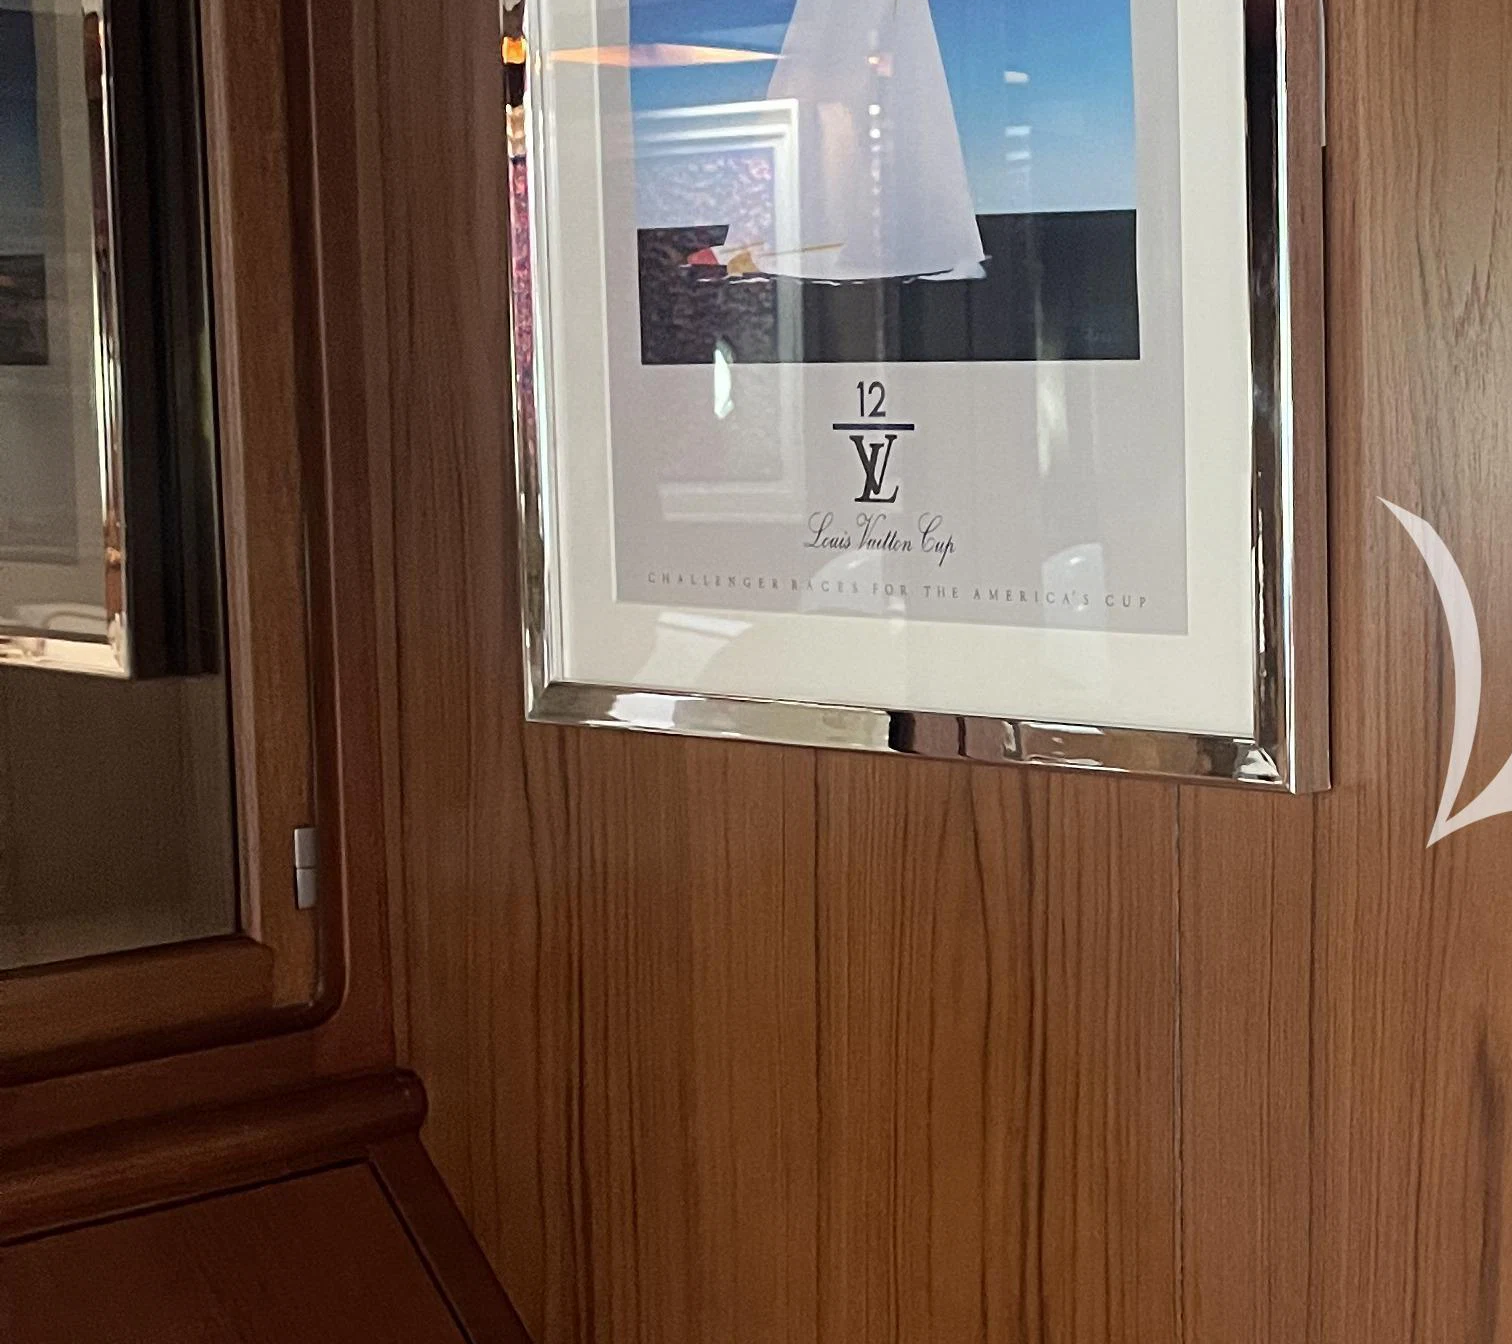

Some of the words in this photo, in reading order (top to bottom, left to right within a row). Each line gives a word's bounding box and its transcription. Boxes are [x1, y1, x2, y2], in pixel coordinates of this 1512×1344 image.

[856, 381, 886, 417] 12
[803, 511, 851, 550] Louis
[856, 512, 913, 552] Vuitton
[918, 512, 955, 567] Cup
[648, 573, 779, 590] CHALLENGER
[791, 576, 859, 594] RACES
[873, 583, 908, 597] FOR
[923, 585, 959, 599] THE
[973, 587, 1090, 605] AMERICA'S
[1105, 594, 1147, 608] CUP
